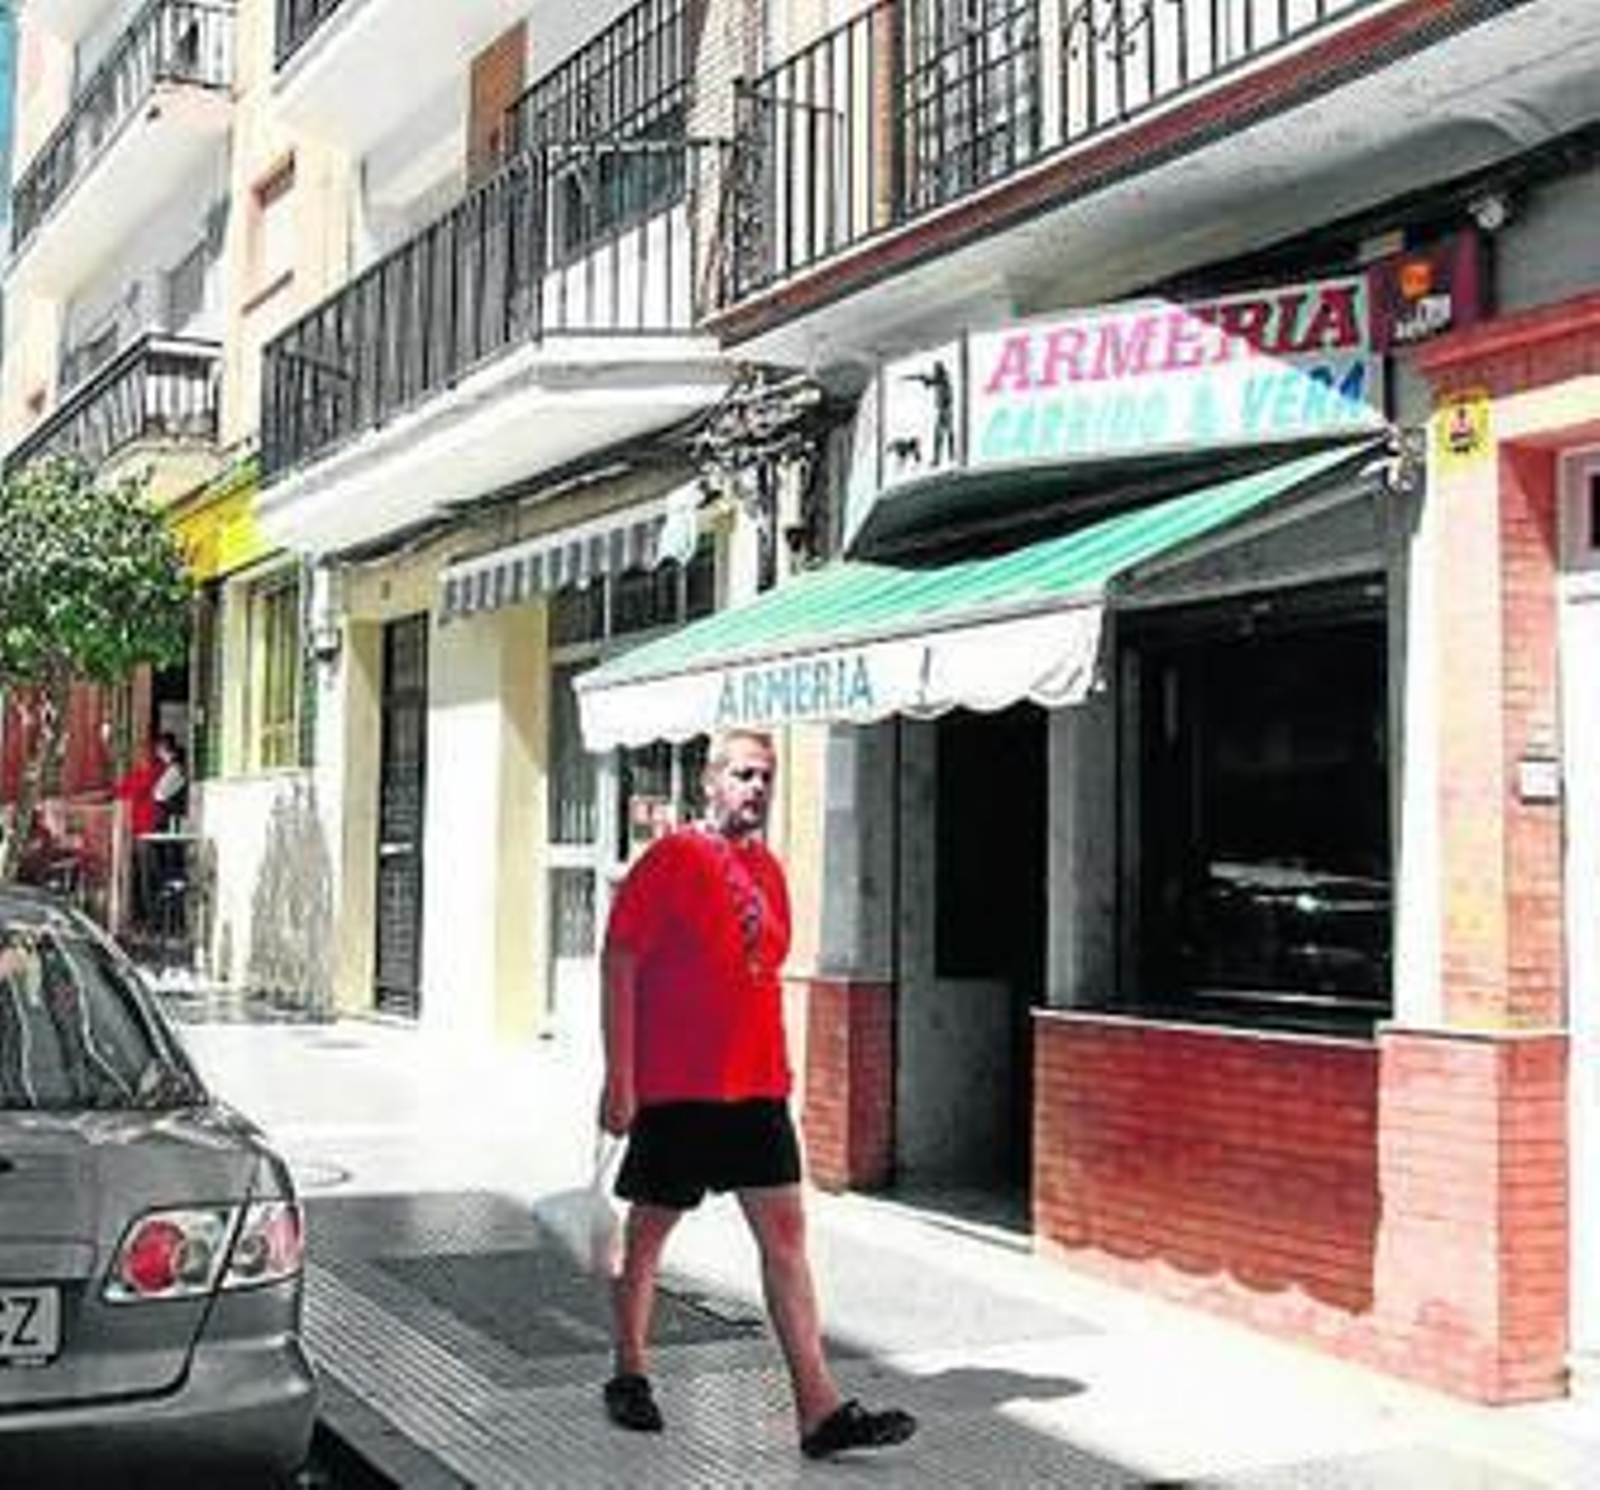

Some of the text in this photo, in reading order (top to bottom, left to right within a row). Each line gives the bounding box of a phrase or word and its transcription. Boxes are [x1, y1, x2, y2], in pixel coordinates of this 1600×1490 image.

[984, 285, 1362, 394] ARMERIA
[714, 655, 874, 723] ARMERIA
[0, 1296, 38, 1346] Z
